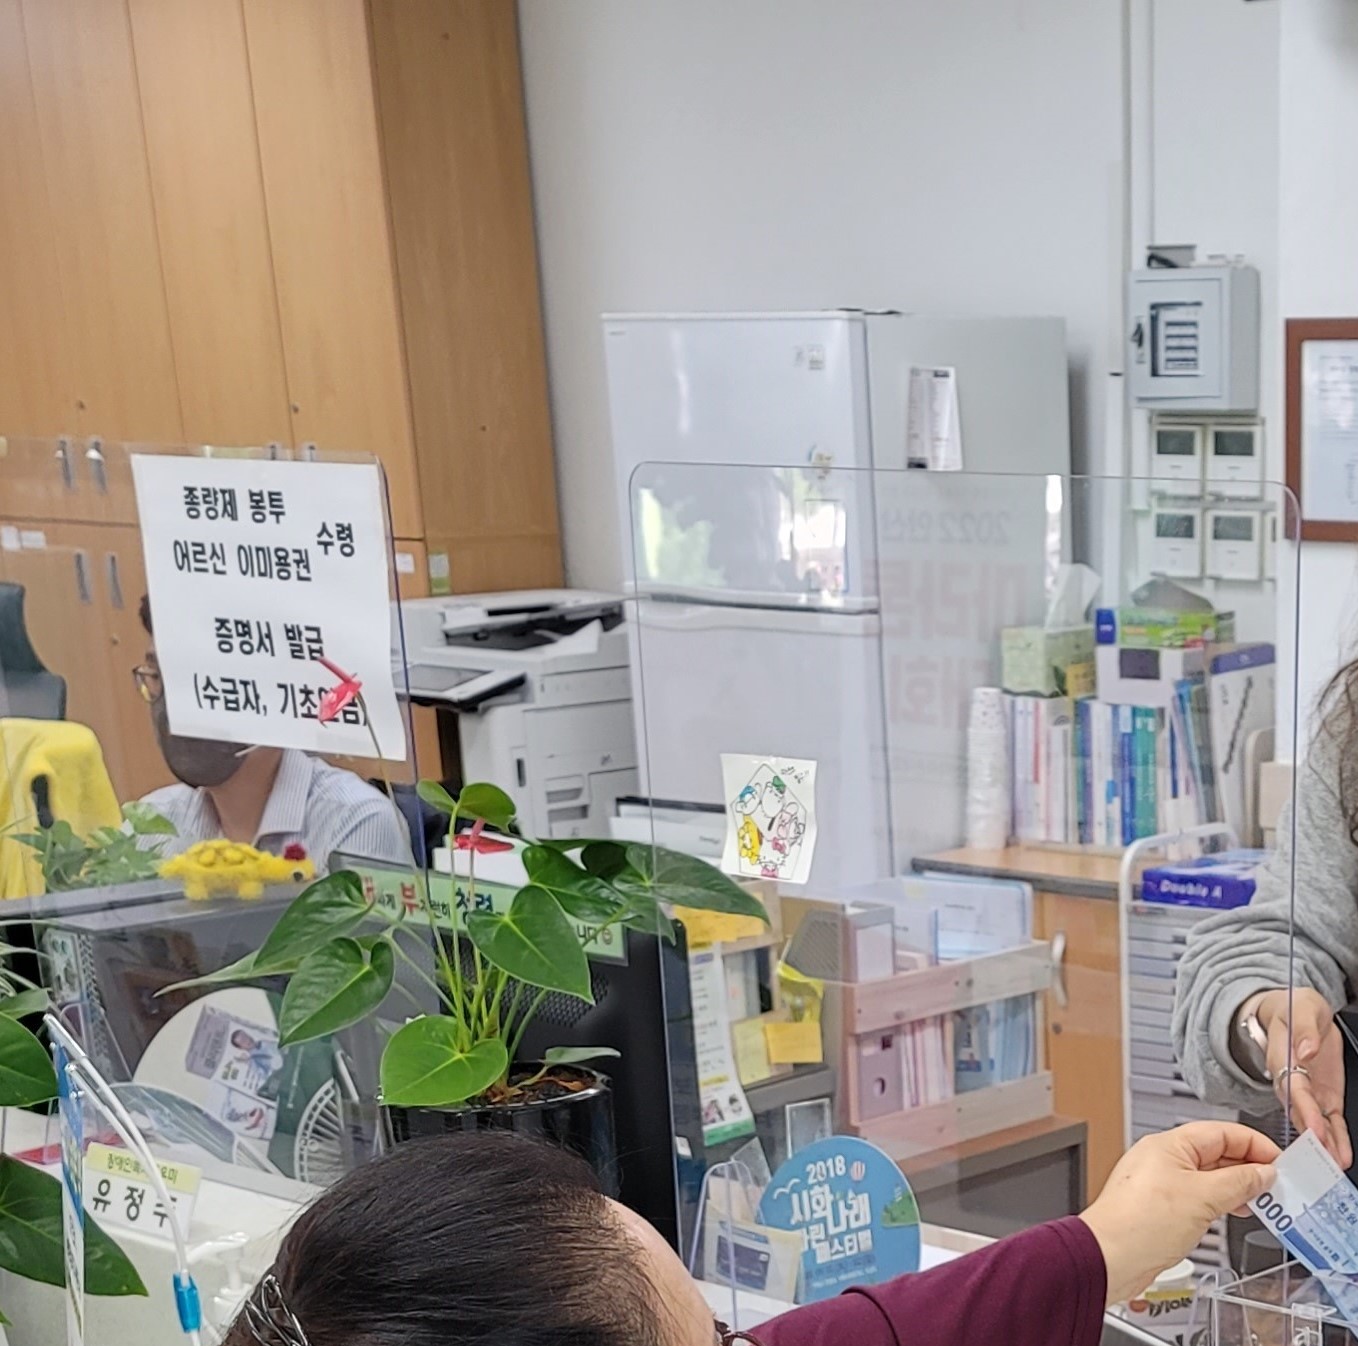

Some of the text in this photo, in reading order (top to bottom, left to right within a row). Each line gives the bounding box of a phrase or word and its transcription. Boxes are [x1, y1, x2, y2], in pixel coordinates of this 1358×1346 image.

[183, 486, 286, 524] 종량제 봉투
[316, 521, 356, 558] 수령
[173, 540, 312, 582] 어르신 이미용권
[214, 617, 325, 661] 증명서 발급
[193, 672, 368, 727] (수급자, 기초금)
[1211, 885, 1223, 898] A
[806, 1155, 847, 1184] 2018
